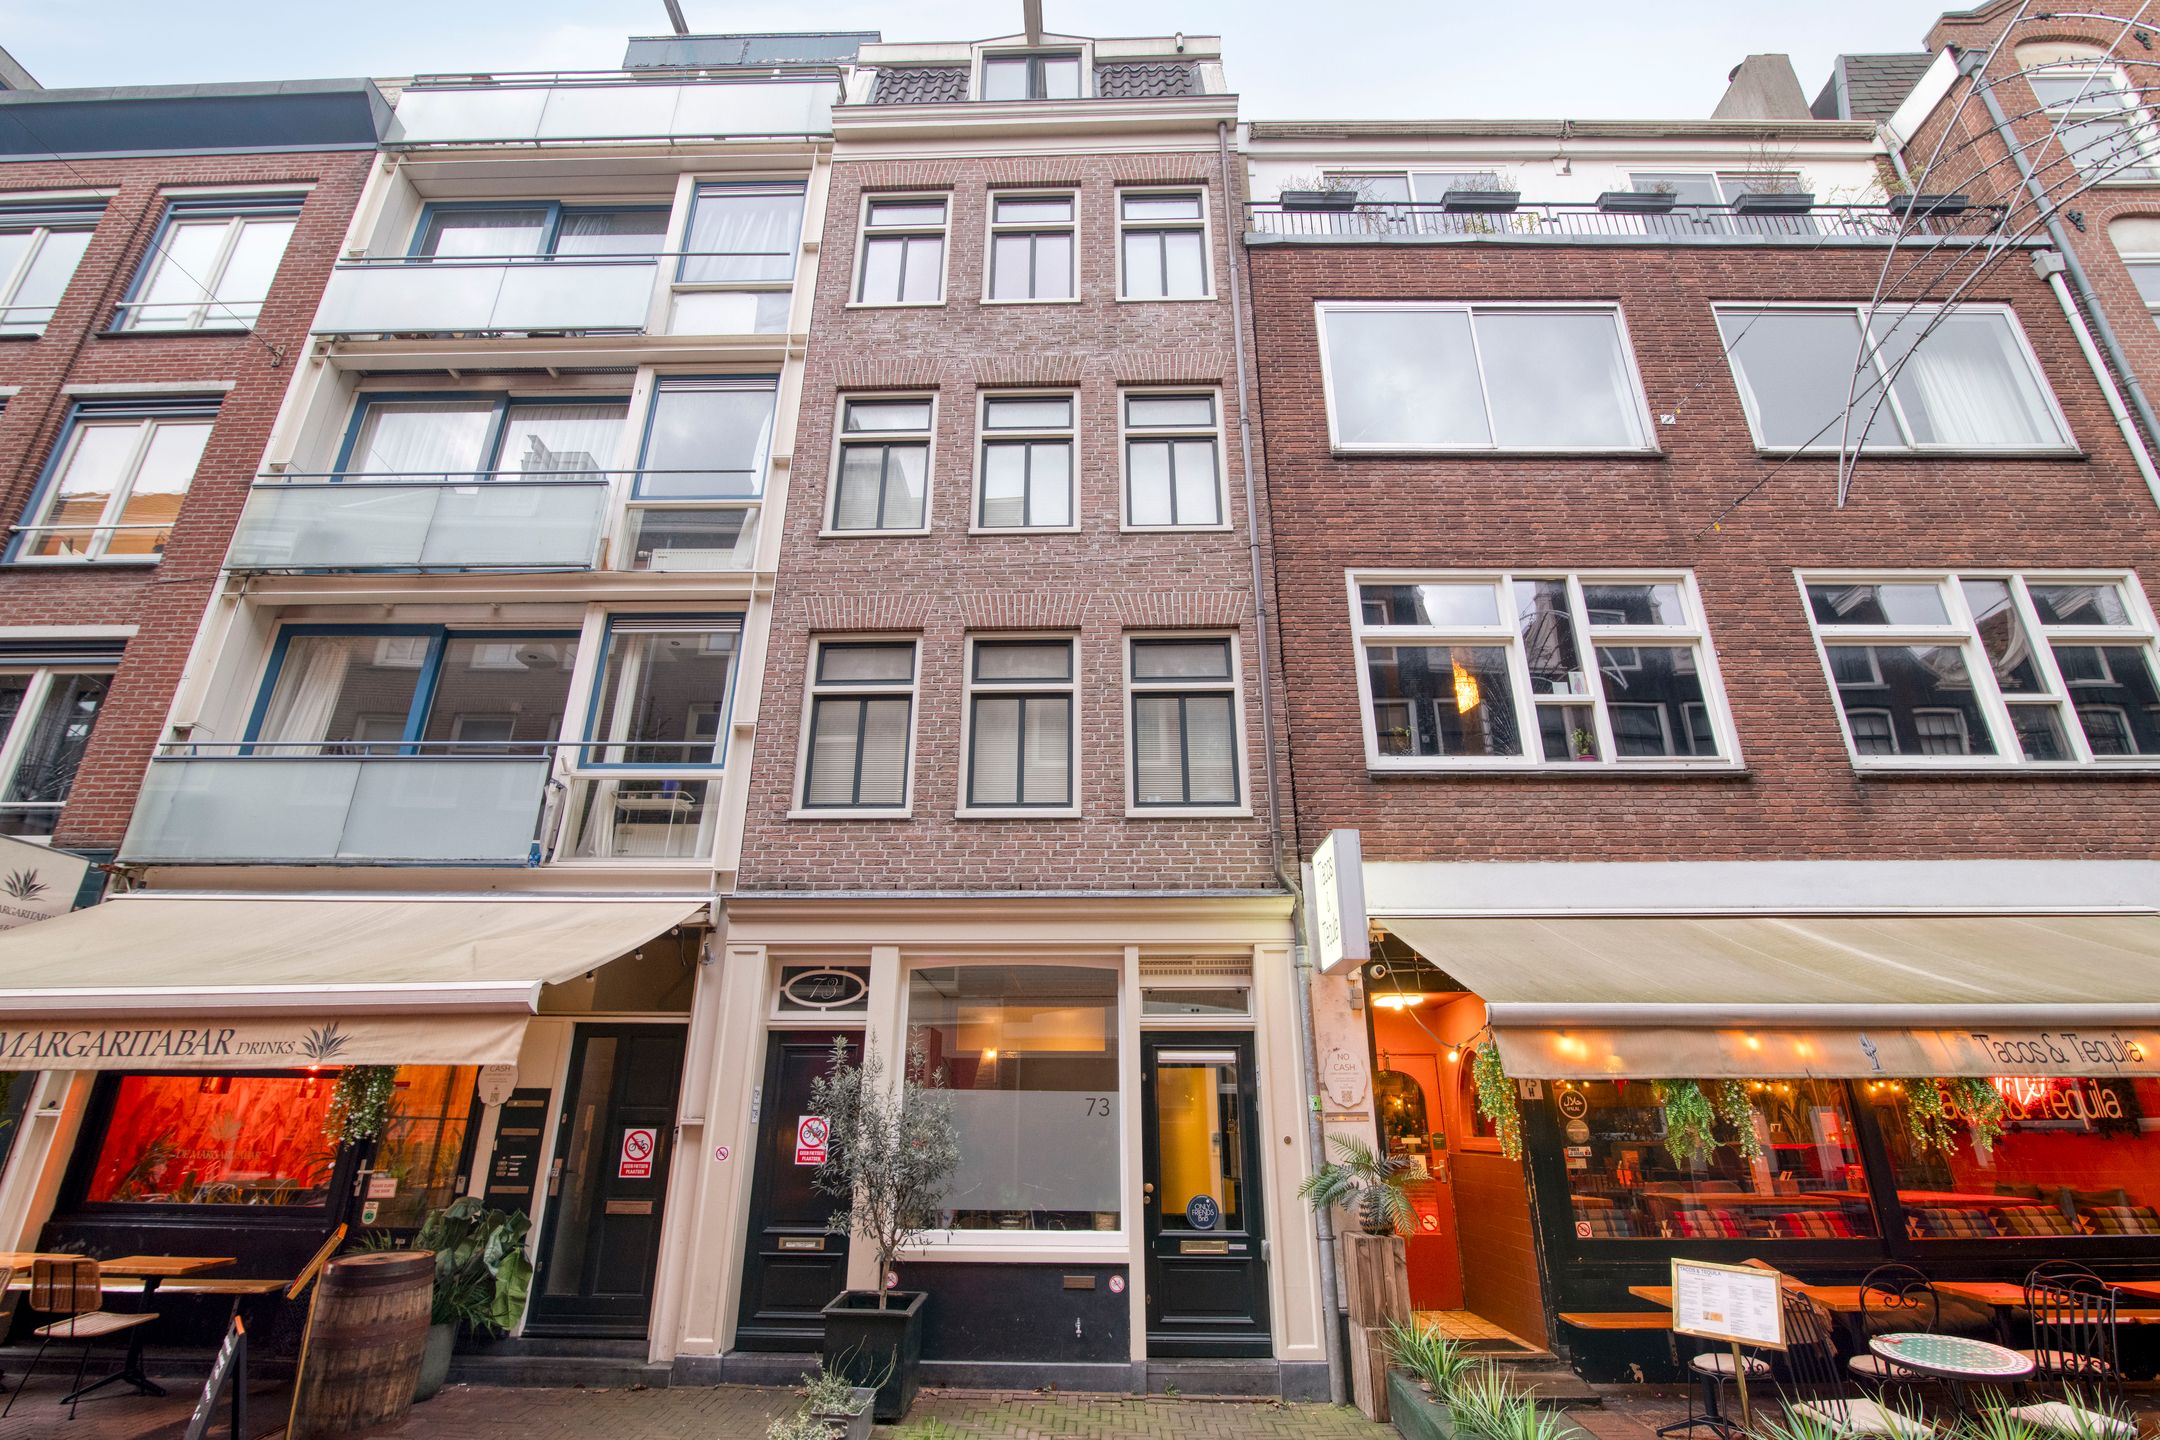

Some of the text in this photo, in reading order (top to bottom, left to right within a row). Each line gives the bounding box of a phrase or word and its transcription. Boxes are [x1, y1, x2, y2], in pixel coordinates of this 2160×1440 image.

[809, 977, 839, 1000] 73
[0, 1028, 296, 1058] MARGARITABAR DRINKS
[1972, 1033, 2144, 1072] Tacos & Tequila
[1333, 1063, 1356, 1071] CASH
[1337, 1053, 1350, 1061] NO
[1085, 1097, 1110, 1117] 73
